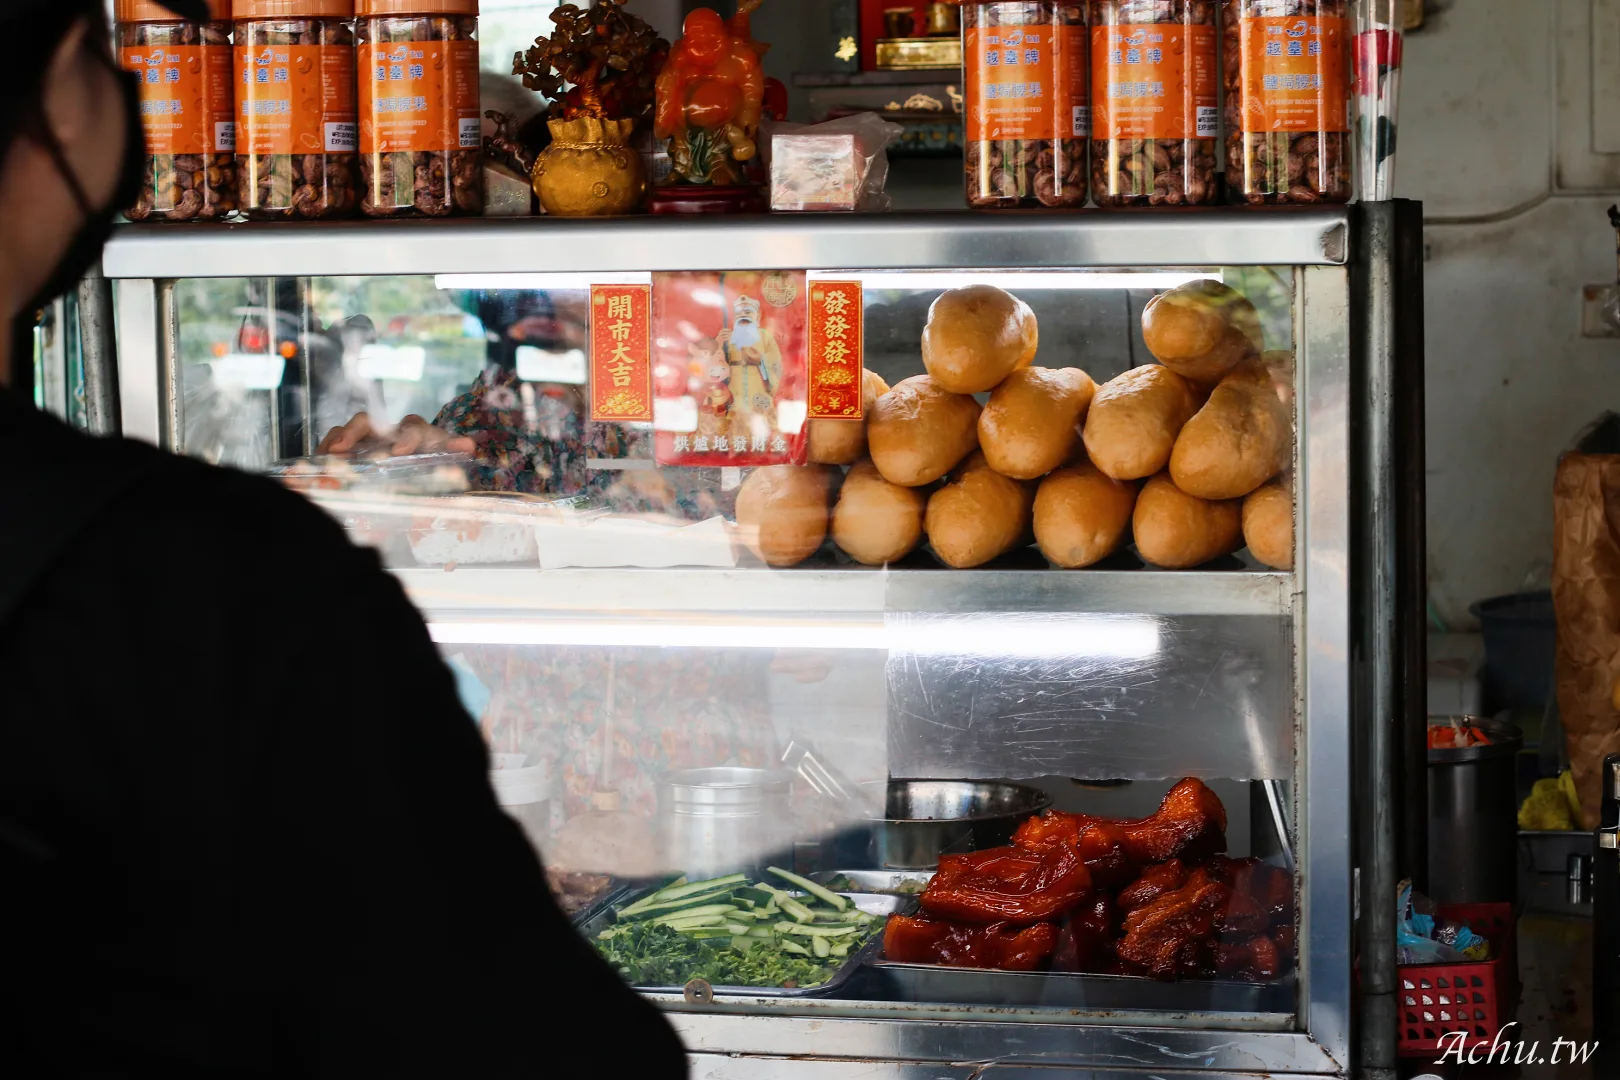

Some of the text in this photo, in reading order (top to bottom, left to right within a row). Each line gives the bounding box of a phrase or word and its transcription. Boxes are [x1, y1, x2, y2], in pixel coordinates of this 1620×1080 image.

[986, 48, 1040, 66] 越臺牌
[1266, 40, 1322, 56] 越臺牌
[822, 290, 851, 364] 發發發
[607, 294, 635, 387] 開市大吉
[673, 435, 788, 452] 烘爐地發財金
